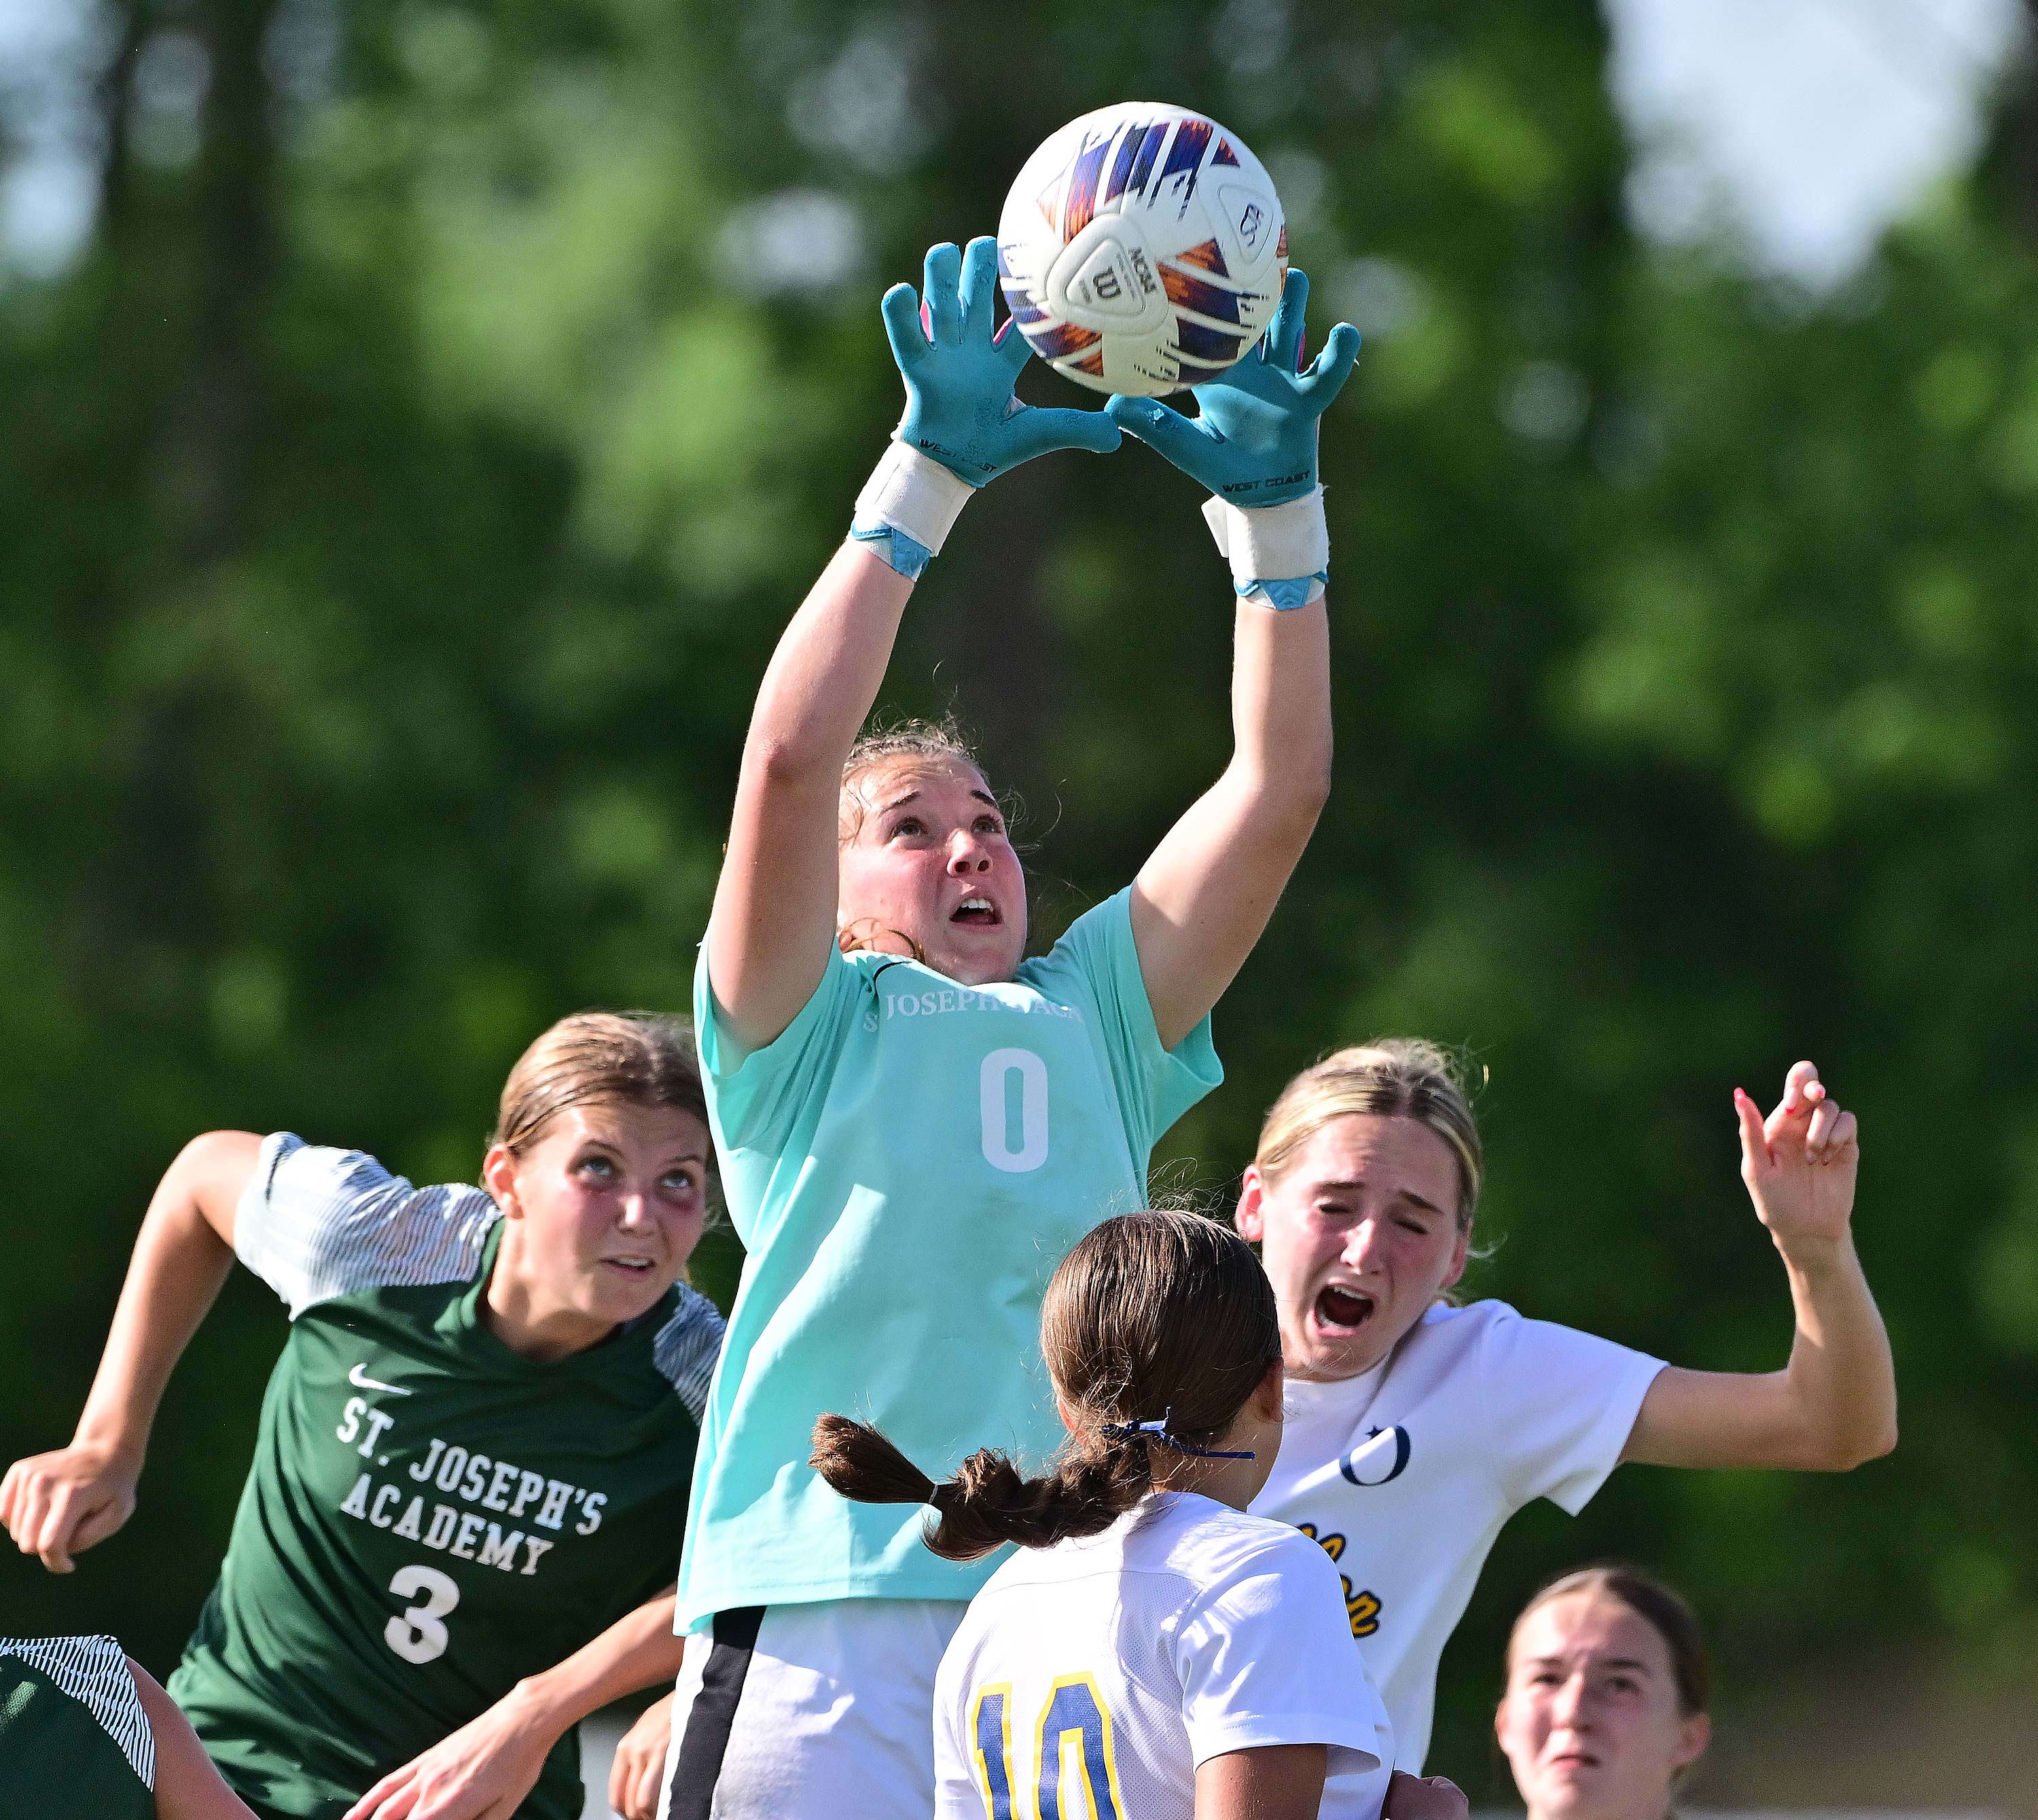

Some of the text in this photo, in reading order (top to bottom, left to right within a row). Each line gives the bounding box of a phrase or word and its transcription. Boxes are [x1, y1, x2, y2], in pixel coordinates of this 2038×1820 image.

[1222, 471, 1310, 493] WEST COAST
[980, 1048, 1048, 1173] 0
[336, 1397, 608, 1536] ST. JOSEPH'S
[340, 1473, 555, 1576] ACADEMY
[384, 1565, 460, 1664] 3
[971, 1671, 1125, 1820] 10
